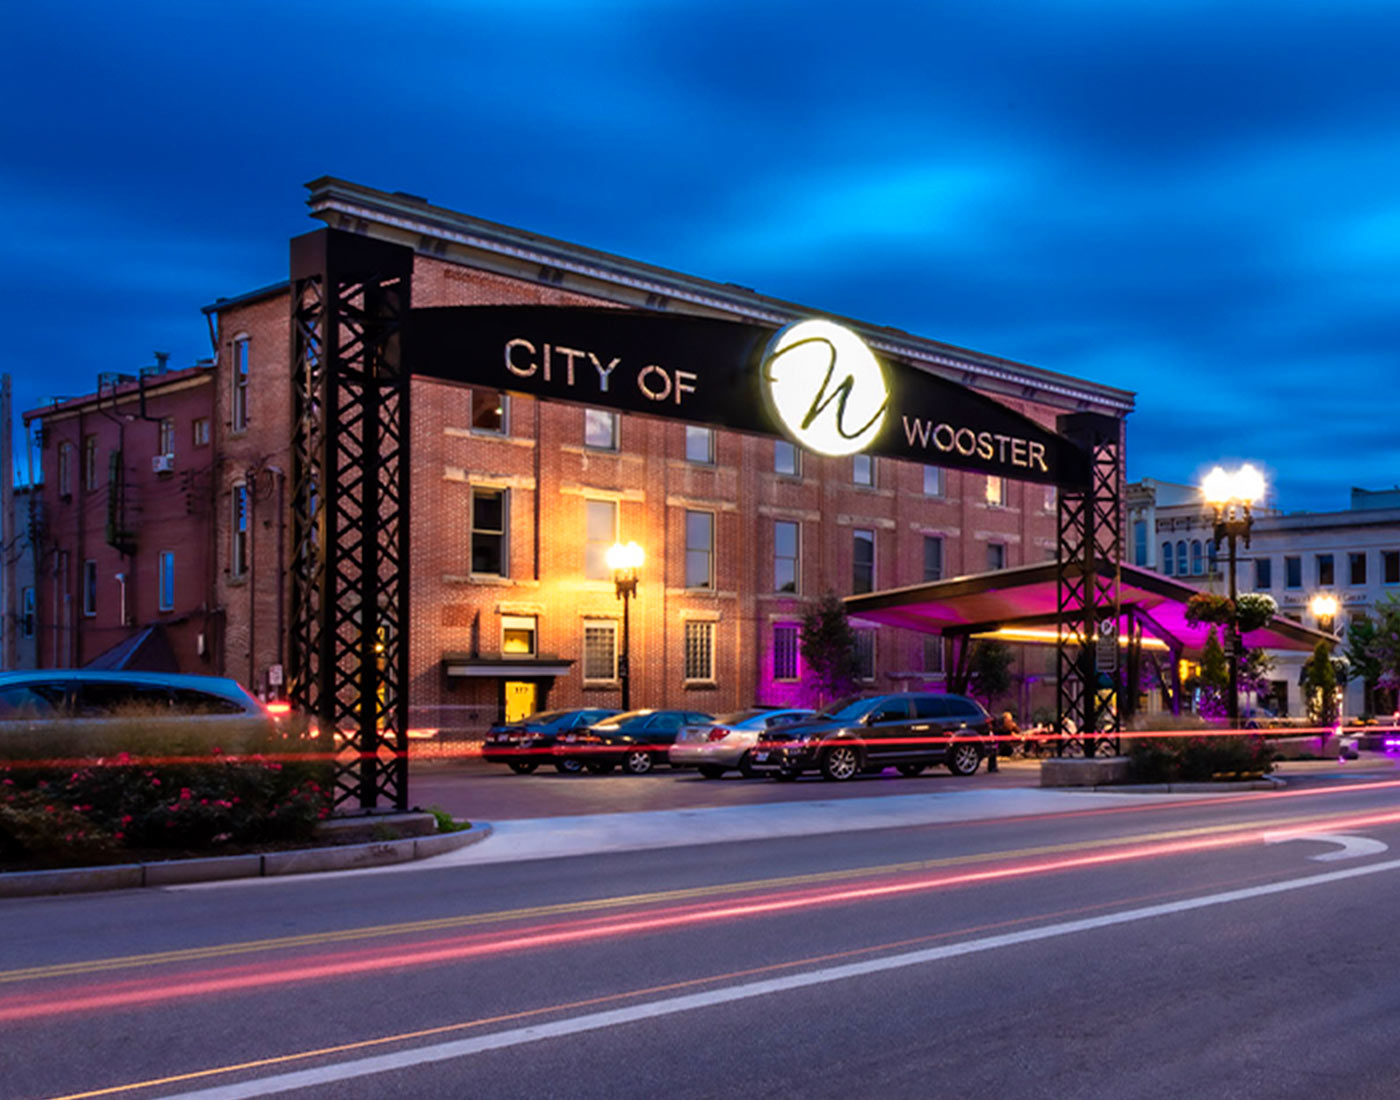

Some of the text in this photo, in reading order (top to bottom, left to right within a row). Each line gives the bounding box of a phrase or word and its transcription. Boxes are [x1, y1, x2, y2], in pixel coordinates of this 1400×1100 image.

[504, 338, 697, 404] CITY OF
[902, 415, 1048, 472] WOOSTER
